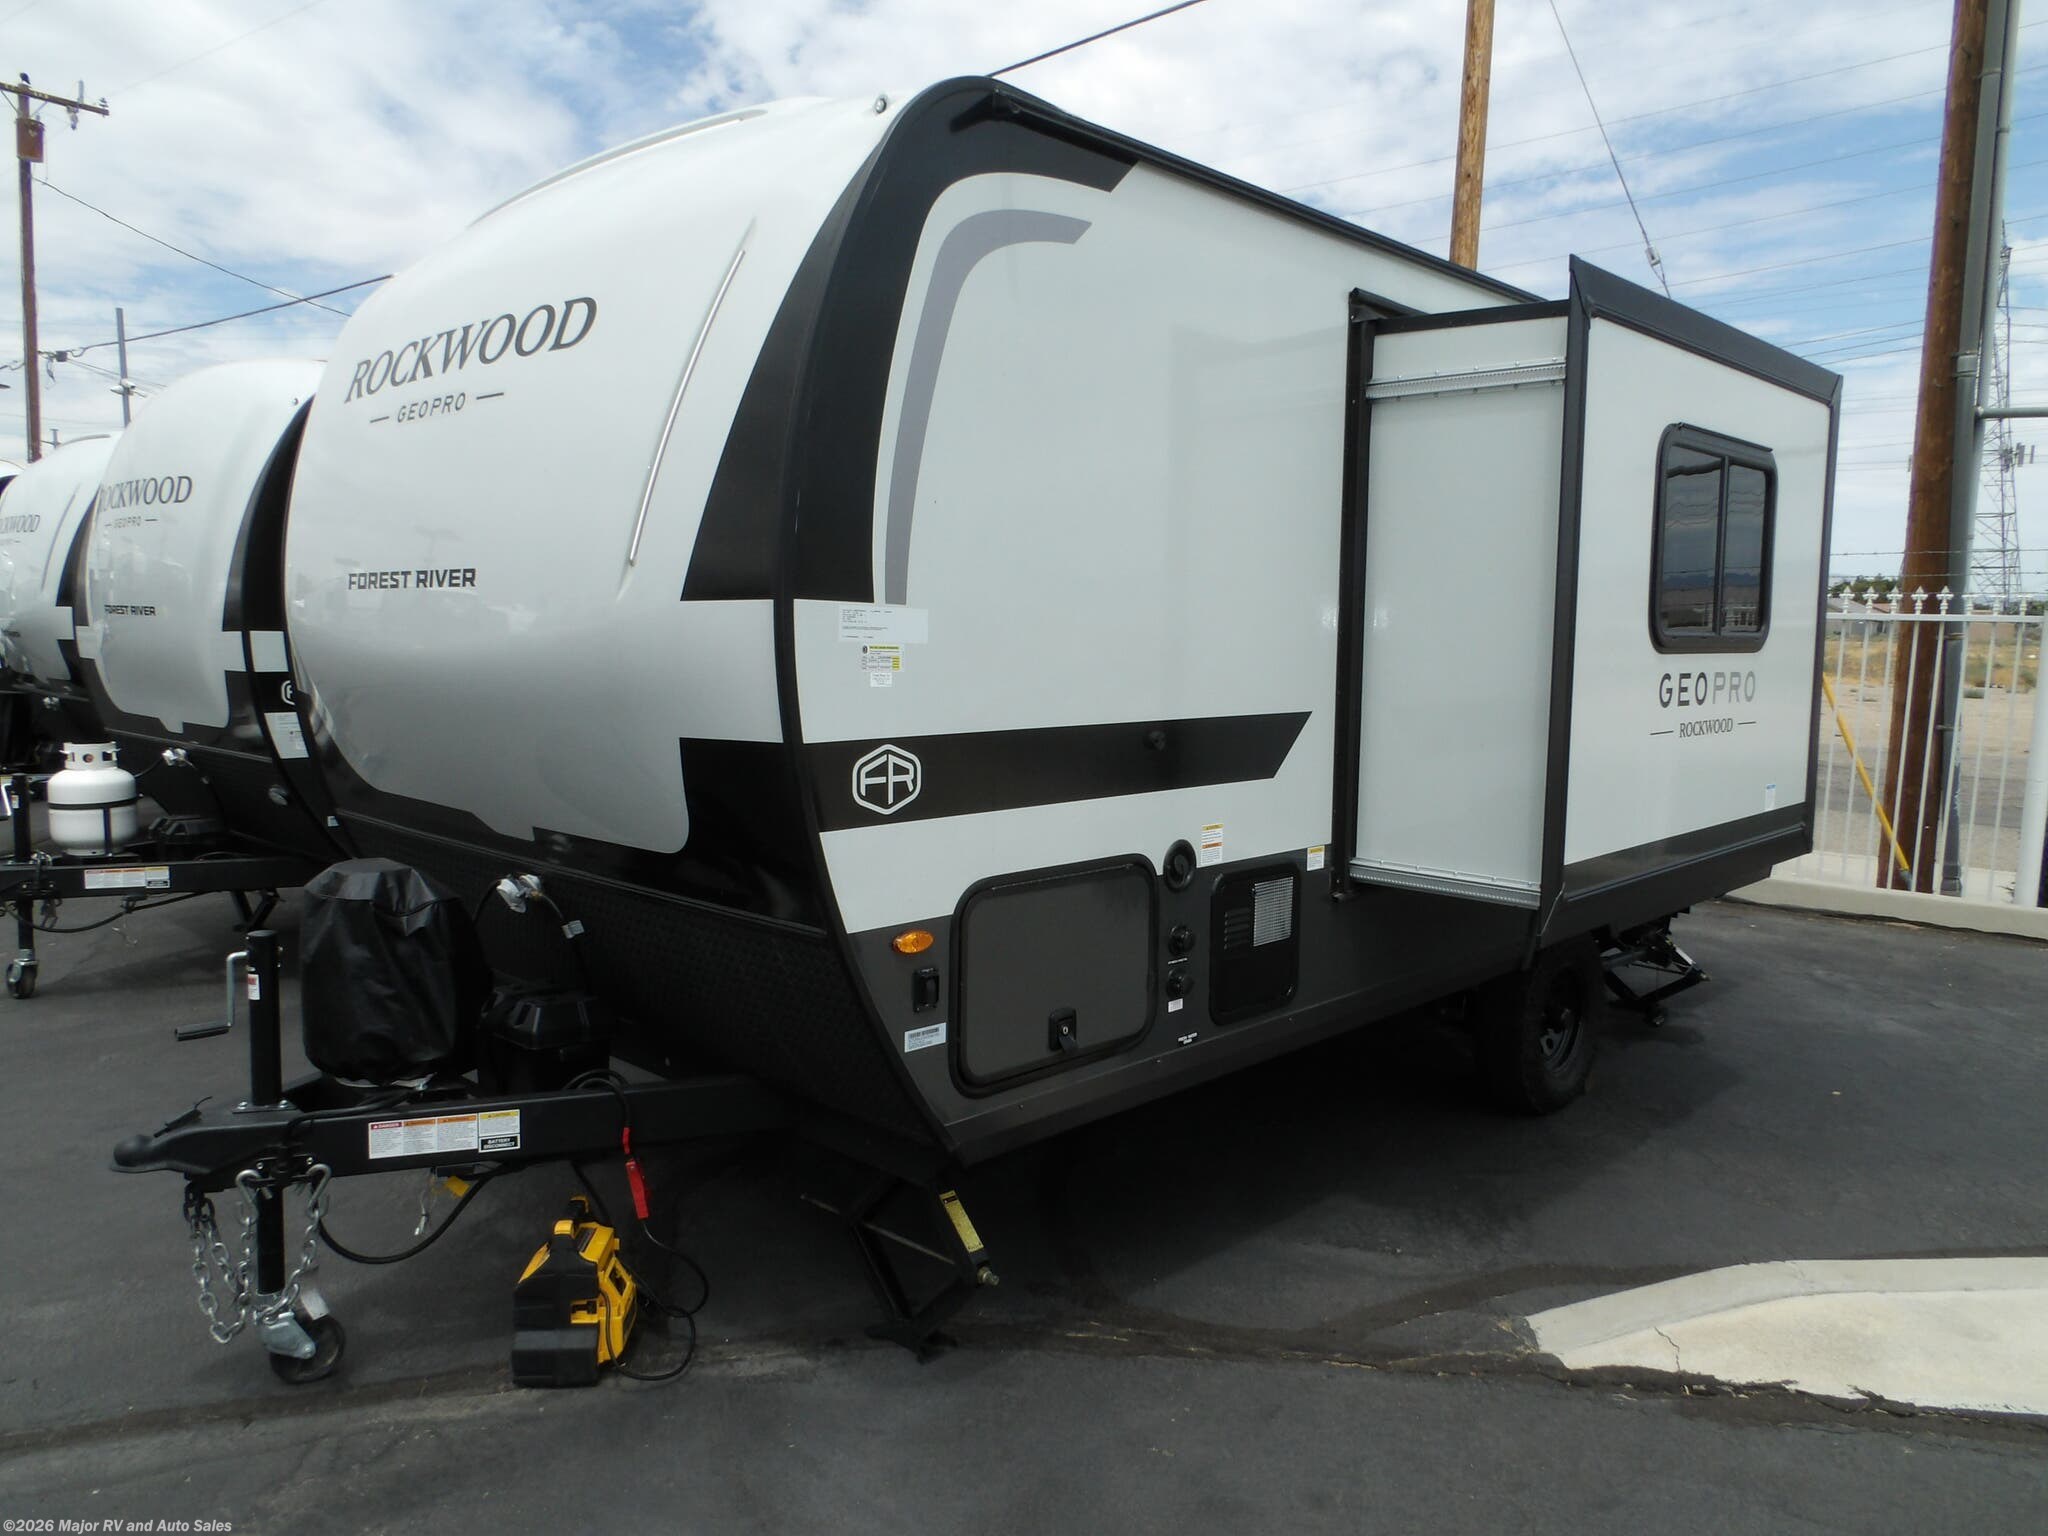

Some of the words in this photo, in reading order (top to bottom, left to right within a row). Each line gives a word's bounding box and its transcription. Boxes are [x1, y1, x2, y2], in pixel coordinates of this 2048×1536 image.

[344, 297, 597, 404] ROCKWOOD
[397, 392, 466, 423] GEOPRO
[348, 570, 411, 590] FOREST
[416, 568, 476, 588] RIVER
[130, 605, 156, 617] RIVER
[1659, 670, 1756, 709] GEOPRO
[1679, 718, 1734, 738] ROCKWOOD
